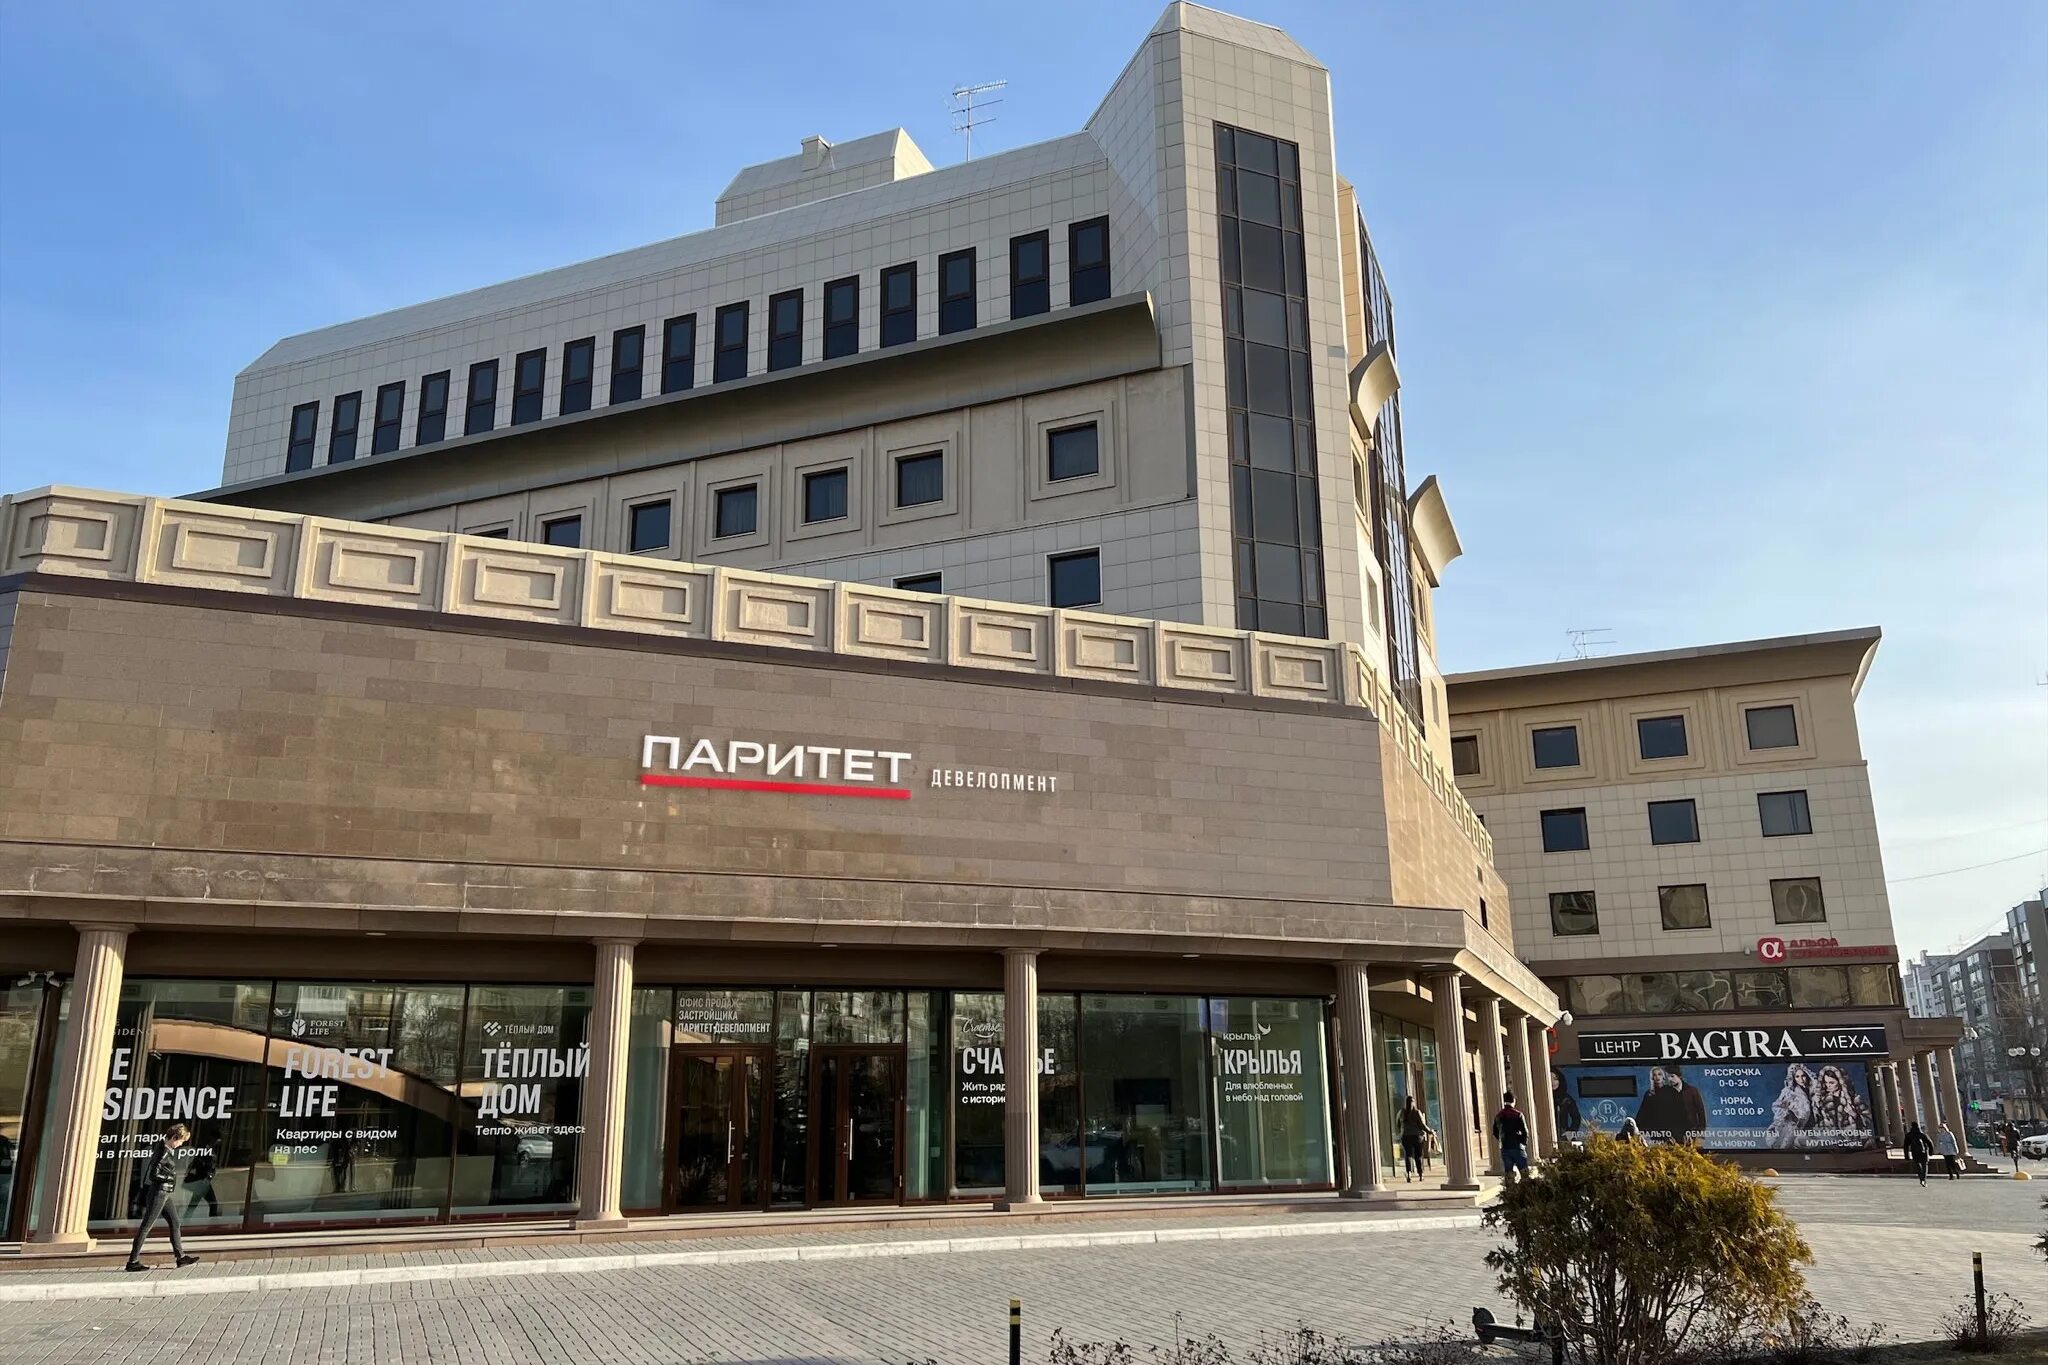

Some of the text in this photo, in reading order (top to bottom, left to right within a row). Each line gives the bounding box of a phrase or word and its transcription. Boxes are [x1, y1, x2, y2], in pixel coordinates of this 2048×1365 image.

[642, 734, 1057, 793] ПАРИТЕТ ДЕВЕЛОПМЕНТ
[680, 998, 703, 1008] ОФИС
[679, 1009, 738, 1021] ЗАСТРОЙЩИКА
[310, 1019, 345, 1027] FOREST
[679, 1022, 770, 1034] ПАРИТЕТ ДЕВЕЛОПМЕНТ
[309, 1028, 330, 1036] LIFE
[504, 1024, 554, 1035] ТЁПЛЫЙ ДОМ
[1223, 1033, 1261, 1041] крылья
[1594, 1029, 1873, 1060] ЦЕНТР BAGIRA МЕХА
[284, 1047, 394, 1080] FOREST
[481, 1041, 591, 1078] ТЁПЛЫЙ
[1224, 1049, 1302, 1075] КРЫЛЬЯ
[1704, 1068, 1761, 1077] РАССРОЧКА
[962, 1082, 1006, 1093] Жить ряд
[1225, 1081, 1294, 1091] Для влюбленных
[1719, 1079, 1749, 1087] 0-0-36
[279, 1085, 339, 1118] LIFE
[477, 1083, 542, 1120] ДОМ
[962, 1096, 969, 1104] с
[1225, 1092, 1304, 1102] в небо над головой
[1720, 1096, 1754, 1105] НОРКА
[102, 1086, 235, 1121] SIDENCE
[1725, 1107, 1736, 1116] 30
[1738, 1107, 1755, 1116] 000
[276, 1128, 397, 1141] Квартиры с видом
[475, 1125, 512, 1136] Тепло
[514, 1125, 551, 1134] живет
[1685, 1130, 1715, 1138] ОБМЕН
[1717, 1129, 1750, 1138] СТАРОЙ
[1793, 1129, 1873, 1137] ШУБЫ НОРКОВЫЕ
[121, 1134, 131, 1143] и
[106, 1150, 115, 1158] в
[177, 1147, 213, 1160] роли
[274, 1145, 318, 1154] на лес
